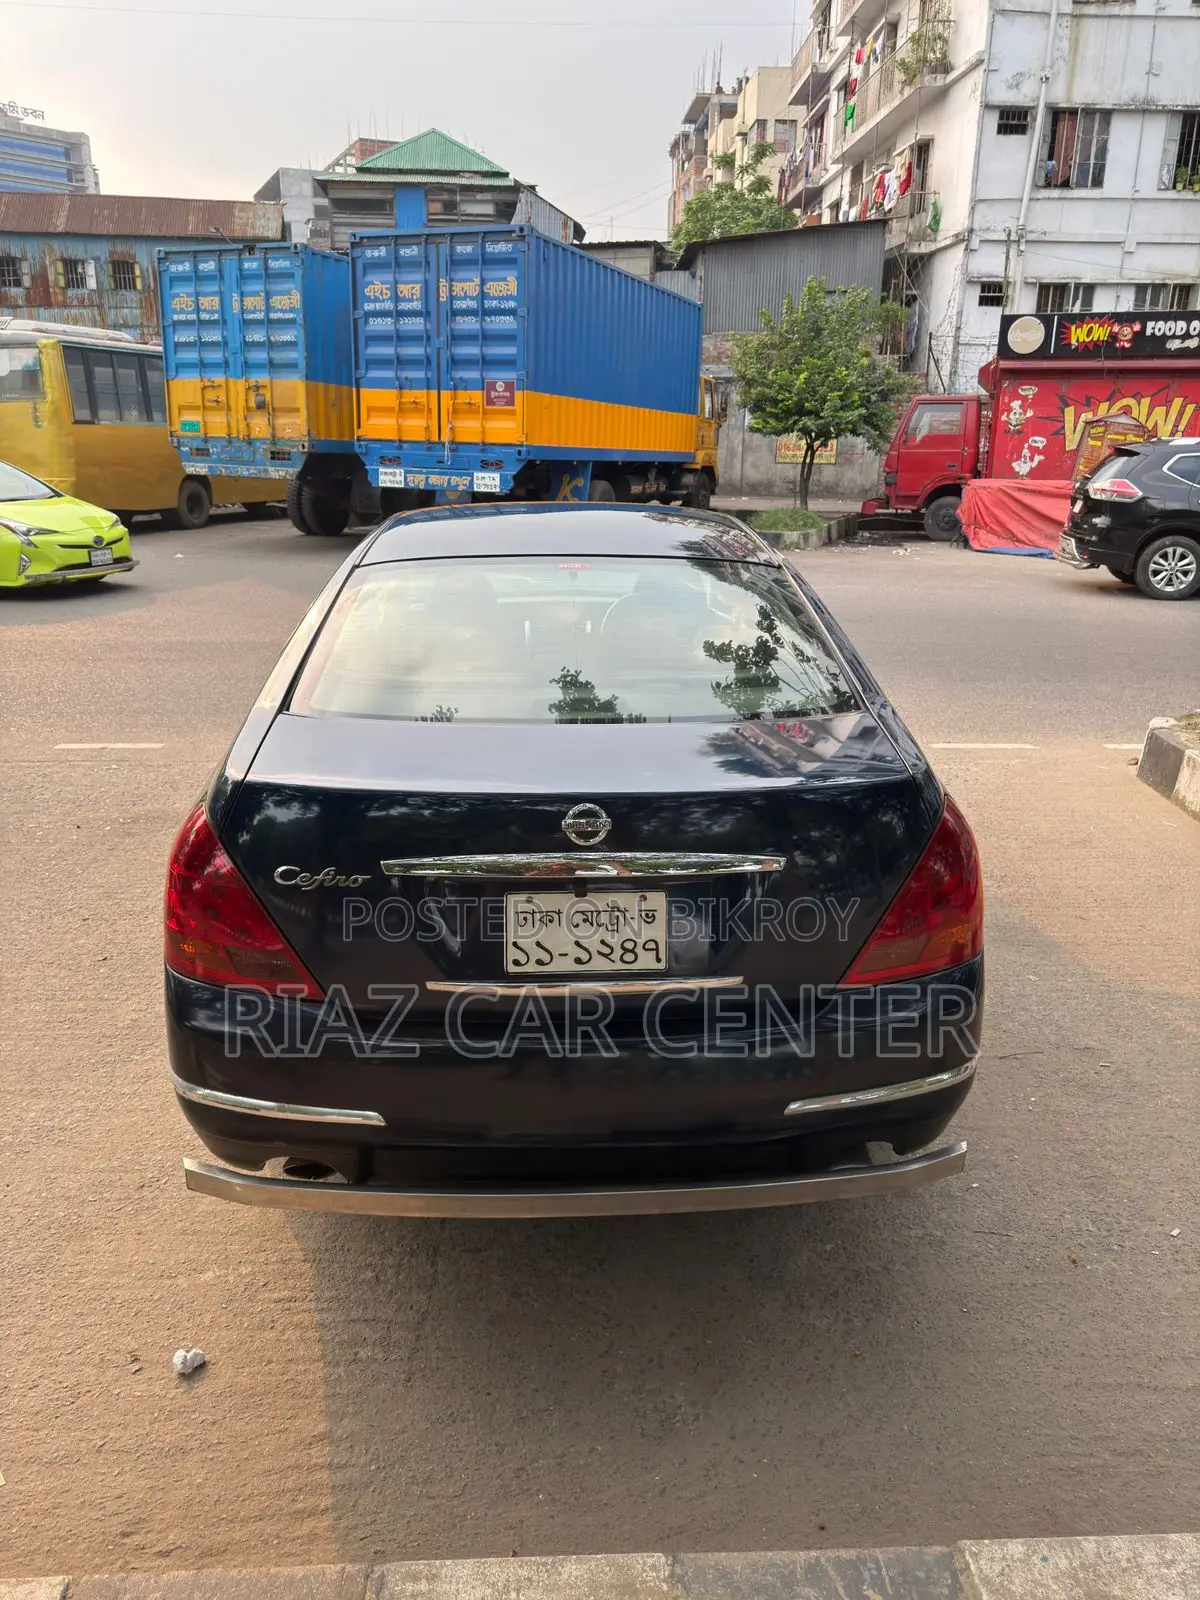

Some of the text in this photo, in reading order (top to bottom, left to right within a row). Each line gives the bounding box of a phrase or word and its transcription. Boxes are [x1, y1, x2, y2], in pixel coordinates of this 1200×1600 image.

[21, 107, 45, 120] ভবন
[364, 281, 391, 300] এইচ
[397, 283, 422, 299] আর
[1071, 323, 1112, 344] WOW!
[1146, 320, 1188, 336] FOOD
[273, 864, 371, 891] Cefiro
[515, 908, 563, 929] ঢাকা
[511, 937, 663, 967] ১১-১২৪৭
